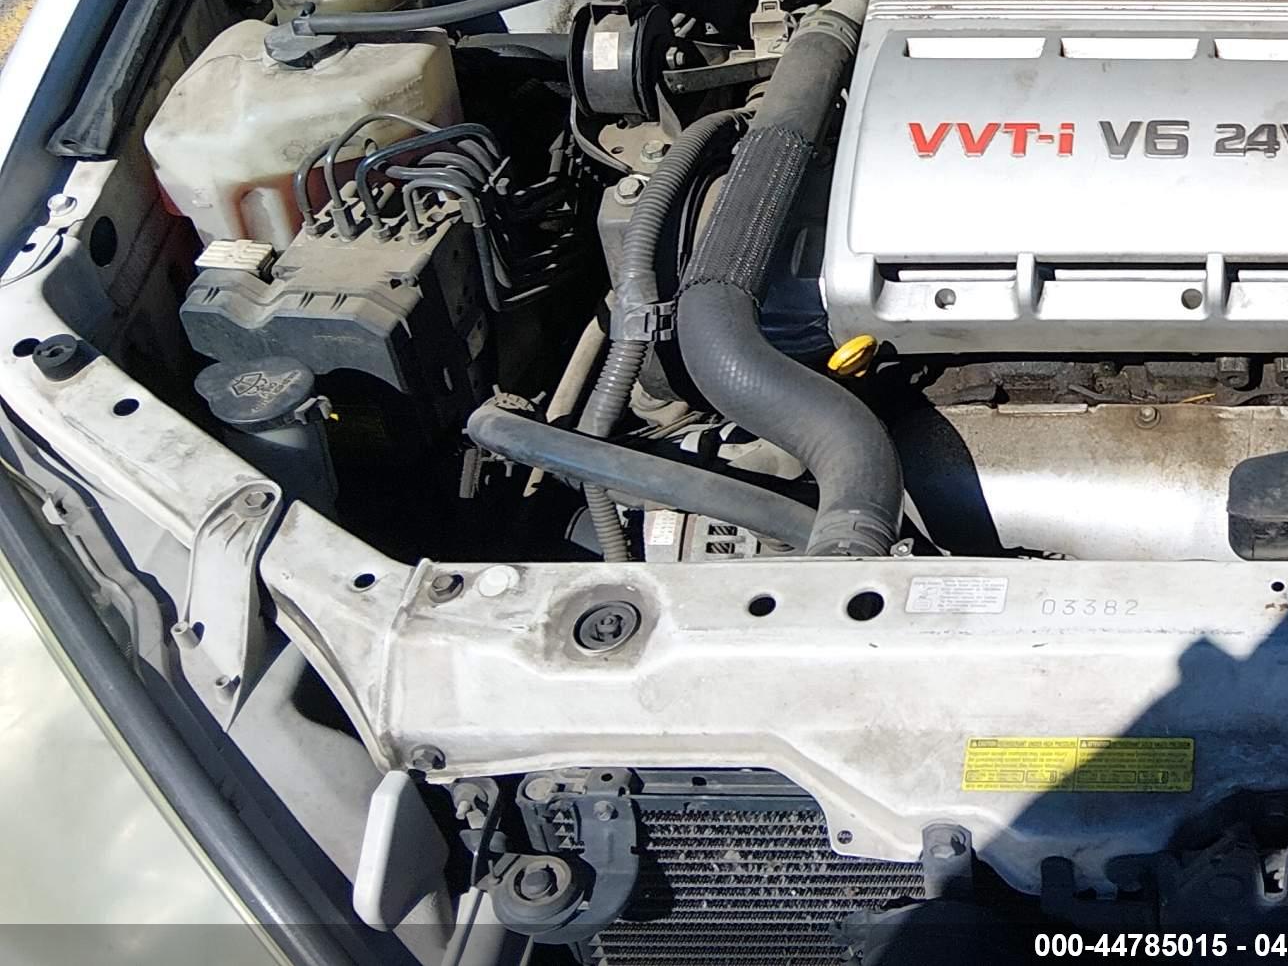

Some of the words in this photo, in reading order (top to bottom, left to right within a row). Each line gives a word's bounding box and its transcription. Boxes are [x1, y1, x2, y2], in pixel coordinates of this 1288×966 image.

[908, 121, 1076, 158] VVT-i
[1099, 120, 1190, 159] V6
[1042, 598, 1139, 615] 03382
